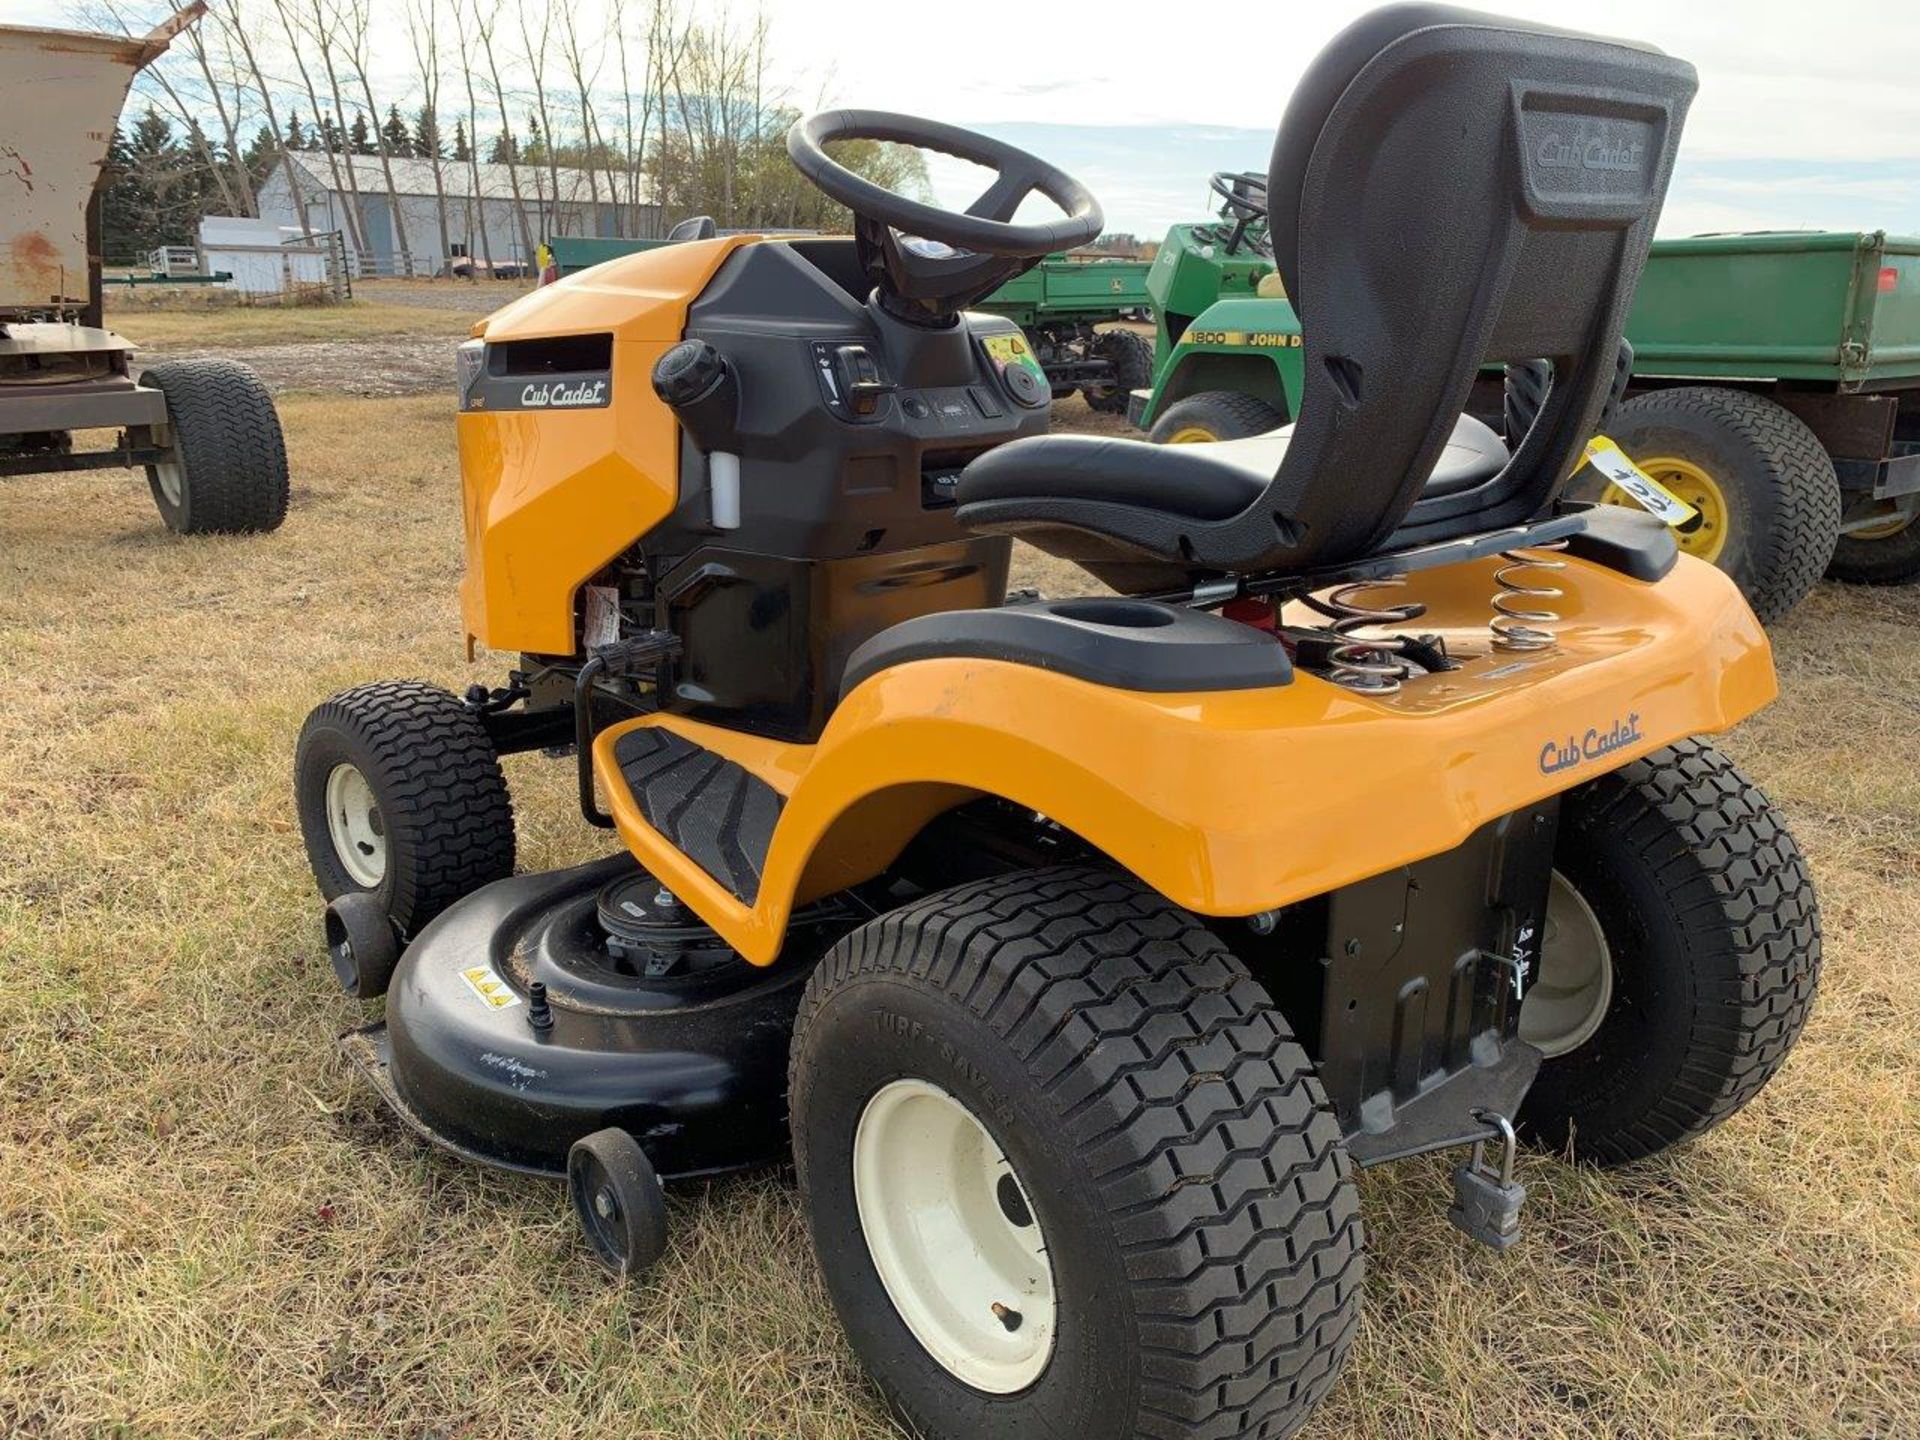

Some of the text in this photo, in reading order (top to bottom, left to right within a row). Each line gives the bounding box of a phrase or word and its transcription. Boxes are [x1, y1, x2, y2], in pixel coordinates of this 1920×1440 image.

[1537, 132, 1643, 172] Cub Cadet
[1191, 332, 1226, 344] 1800
[1250, 333, 1304, 347] JOHN D
[521, 380, 605, 406] Cub Cadet
[1540, 712, 1641, 774] Cub Cadet
